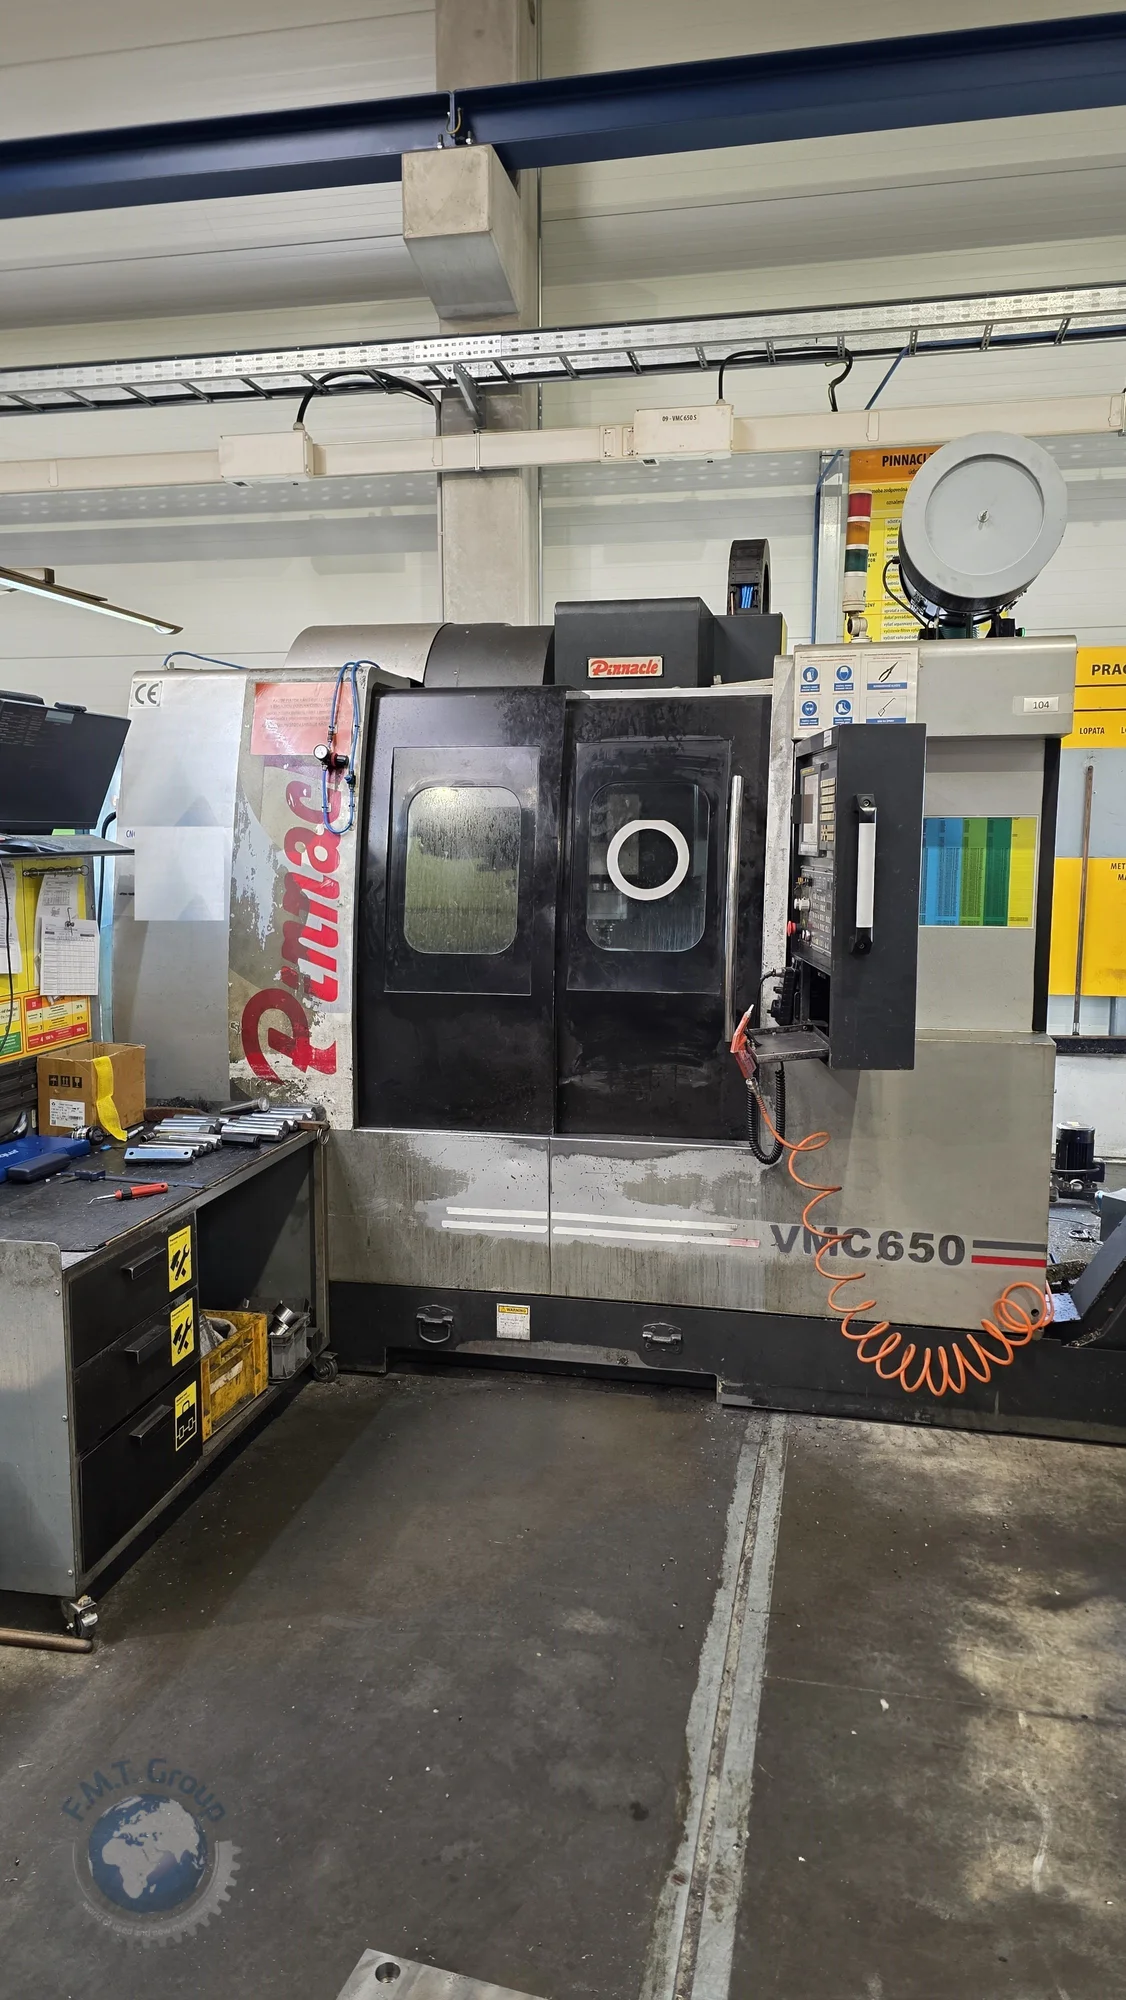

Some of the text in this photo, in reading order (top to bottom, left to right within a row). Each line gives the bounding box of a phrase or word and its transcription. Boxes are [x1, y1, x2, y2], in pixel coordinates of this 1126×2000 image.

[590, 660, 659, 676] Pinnacle
[135, 683, 159, 705] CE
[1033, 701, 1050, 710] 104
[1079, 727, 1105, 735] LOPATA
[126, 830, 135, 838] CN
[241, 754, 342, 1086] Pinnac
[770, 1224, 966, 1266] VMC650
